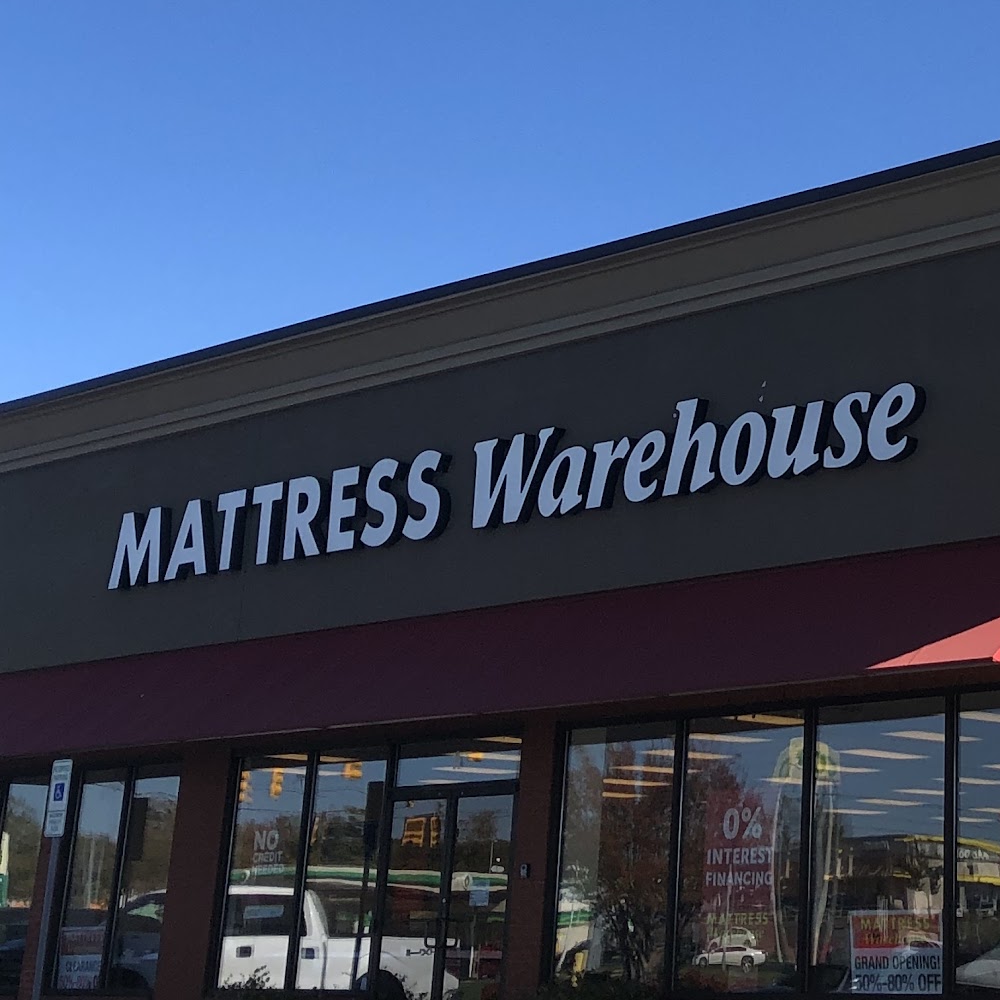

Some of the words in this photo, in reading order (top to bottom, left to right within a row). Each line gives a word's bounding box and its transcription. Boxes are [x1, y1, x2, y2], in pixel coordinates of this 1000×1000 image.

[107, 449, 447, 590] MATTRESS
[472, 381, 918, 529] Warehouse
[722, 806, 763, 840] 0%
[253, 829, 280, 850] NO
[252, 850, 283, 864] CREDIT
[706, 846, 773, 866] INTEREST
[251, 863, 285, 876] NEEDED
[705, 870, 774, 888] FINANCING
[854, 955, 890, 970] GRAND
[892, 954, 941, 970] OPENING!
[855, 973, 915, 992] 50%-80%
[917, 973, 941, 992] OFF
